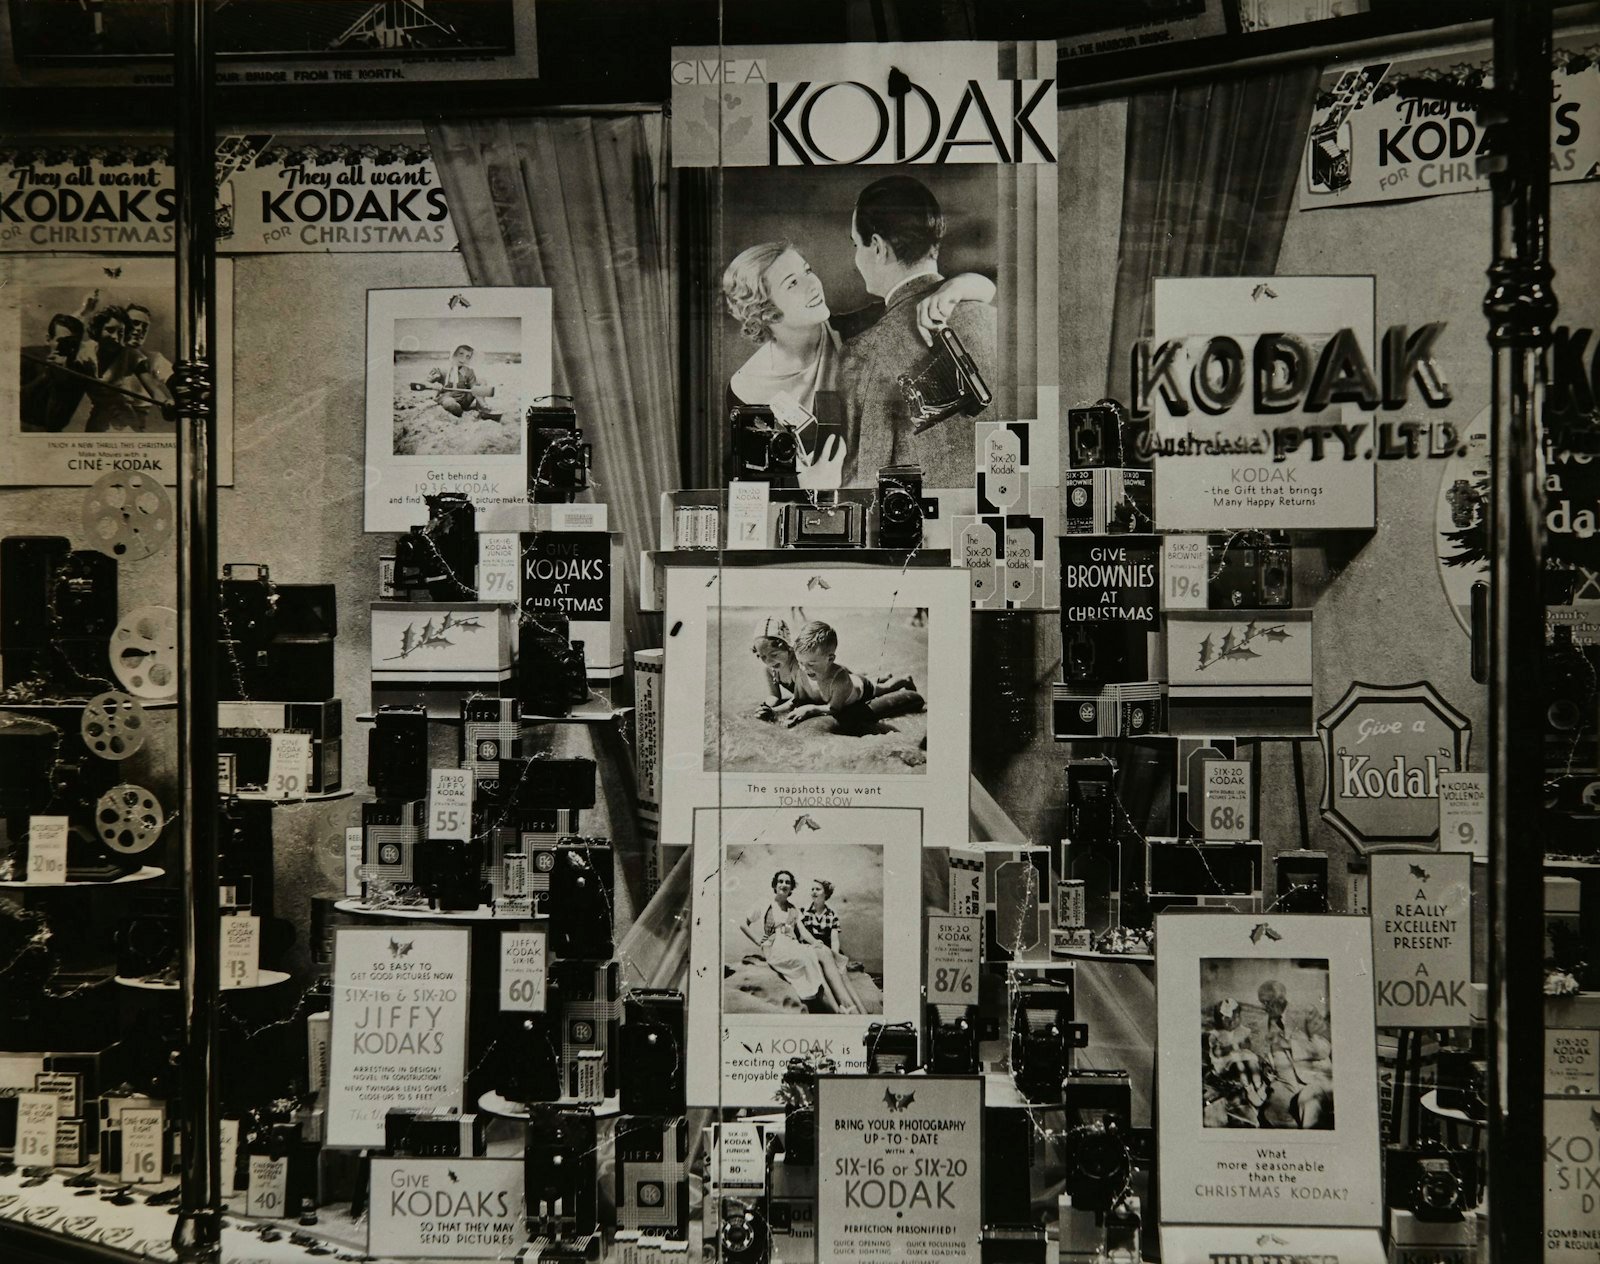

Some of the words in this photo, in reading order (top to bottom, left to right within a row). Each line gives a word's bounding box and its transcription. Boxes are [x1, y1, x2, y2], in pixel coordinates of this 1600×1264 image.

[294, 71, 328, 81] FROM
[333, 70, 352, 80] THE
[671, 59, 736, 85] GIVE
[745, 60, 767, 84] A
[769, 79, 1056, 166] KODAK
[8, 165, 60, 189] They
[70, 165, 96, 186] all
[99, 168, 161, 187] want
[278, 165, 331, 189] They
[337, 165, 363, 186] all
[365, 168, 431, 187] want
[1379, 167, 1409, 191] FOR
[0, 189, 176, 223] KODAKS
[262, 188, 448, 223] KODAKS
[2, 226, 21, 241] OR
[30, 225, 174, 244] CHRISTMAS
[263, 227, 292, 245] FOR
[300, 224, 444, 244] CHRISTMAS
[1131, 322, 1452, 418] KODAK
[991, 440, 1003, 451] The
[991, 453, 1016, 463] Six-20
[991, 465, 1015, 474] Kodak
[1231, 468, 1297, 483] KODAK
[427, 471, 444, 481] Get
[447, 471, 479, 480] behind
[415, 483, 449, 494] 1936
[454, 483, 499, 494] KODAK
[1234, 485, 1256, 496] Gift
[1260, 486, 1284, 495] that
[1289, 486, 1323, 497] brings
[406, 496, 421, 504] find
[476, 496, 501, 505] picture
[503, 496, 525, 504] maker
[1213, 497, 1242, 508] Many
[1247, 497, 1275, 508] Happy
[1279, 497, 1316, 506] Returns
[966, 534, 979, 545] The
[547, 544, 579, 556] GIVE
[966, 546, 992, 557] Six-20
[1090, 548, 1126, 561] GIVE
[525, 558, 604, 580] KODAKS
[966, 558, 992, 568] Kodak
[1067, 565, 1154, 588] BROWNIES
[553, 583, 570, 594] AT
[1100, 591, 1118, 603] AT
[525, 597, 604, 612] CHRISTMAS
[1068, 607, 1154, 621] CHRISTMAS
[1357, 718, 1401, 744] Give
[1412, 719, 1426, 733] a
[1214, 768, 1243, 776] SIX-20
[1210, 776, 1245, 785] KODAK
[1448, 782, 1481, 791] KODAK
[747, 784, 767, 794] The
[773, 784, 826, 796] snapshots
[830, 786, 849, 796] you
[855, 785, 882, 795] want
[1443, 792, 1485, 800] VOLLENDA
[1415, 888, 1427, 900] A
[1395, 904, 1448, 917] REALLY
[1385, 920, 1457, 933] EXCELLENT
[510, 939, 538, 947] JIFFY
[937, 933, 972, 941] KODAK
[506, 948, 541, 956] KODAK
[373, 962, 385, 971] SO
[390, 962, 414, 971] EASY
[420, 962, 432, 971] TO
[1415, 962, 1429, 977] A
[351, 972, 366, 980] GET
[370, 972, 393, 980] GOOD
[395, 972, 431, 980] PICTURES
[433, 972, 453, 980] NOW
[345, 988, 390, 1002] SIX-16
[414, 989, 457, 1002] SIX-20
[1377, 980, 1467, 1007] KODAK
[355, 1006, 442, 1030] JIFFY
[353, 1032, 444, 1054] KODAKS
[755, 1042, 763, 1053] A
[771, 1039, 834, 1054] KODAK
[842, 1045, 850, 1054] is
[1553, 1046, 1591, 1055] KODAK
[1558, 1056, 1585, 1064] DUO
[835, 1119, 864, 1131] BRING
[868, 1119, 896, 1131] YOUR
[900, 1120, 966, 1131] PHOTOGRAPHY
[1256, 1149, 1288, 1160] What
[835, 1158, 884, 1176] SIX-16
[893, 1164, 908, 1176] or
[914, 1158, 967, 1177] SIX-20
[1217, 1162, 1248, 1170] more
[1255, 1160, 1325, 1173] seasonable
[1248, 1172, 1276, 1183] than
[1279, 1172, 1297, 1183] the
[845, 1180, 956, 1209] KODAK
[1195, 1184, 1281, 1199] CHRISTMAS
[1290, 1186, 1349, 1201] KODAK?
[391, 1190, 508, 1217] KODAKS
[420, 1222, 433, 1232] SO
[437, 1222, 462, 1232] THAT
[465, 1222, 490, 1233] THEY
[494, 1222, 514, 1232] MAY
[844, 1225, 893, 1234] PERFECTION
[896, 1225, 956, 1234] PERSONIFIED!
[420, 1233, 453, 1244] SEND
[457, 1233, 514, 1245] PICTURES
